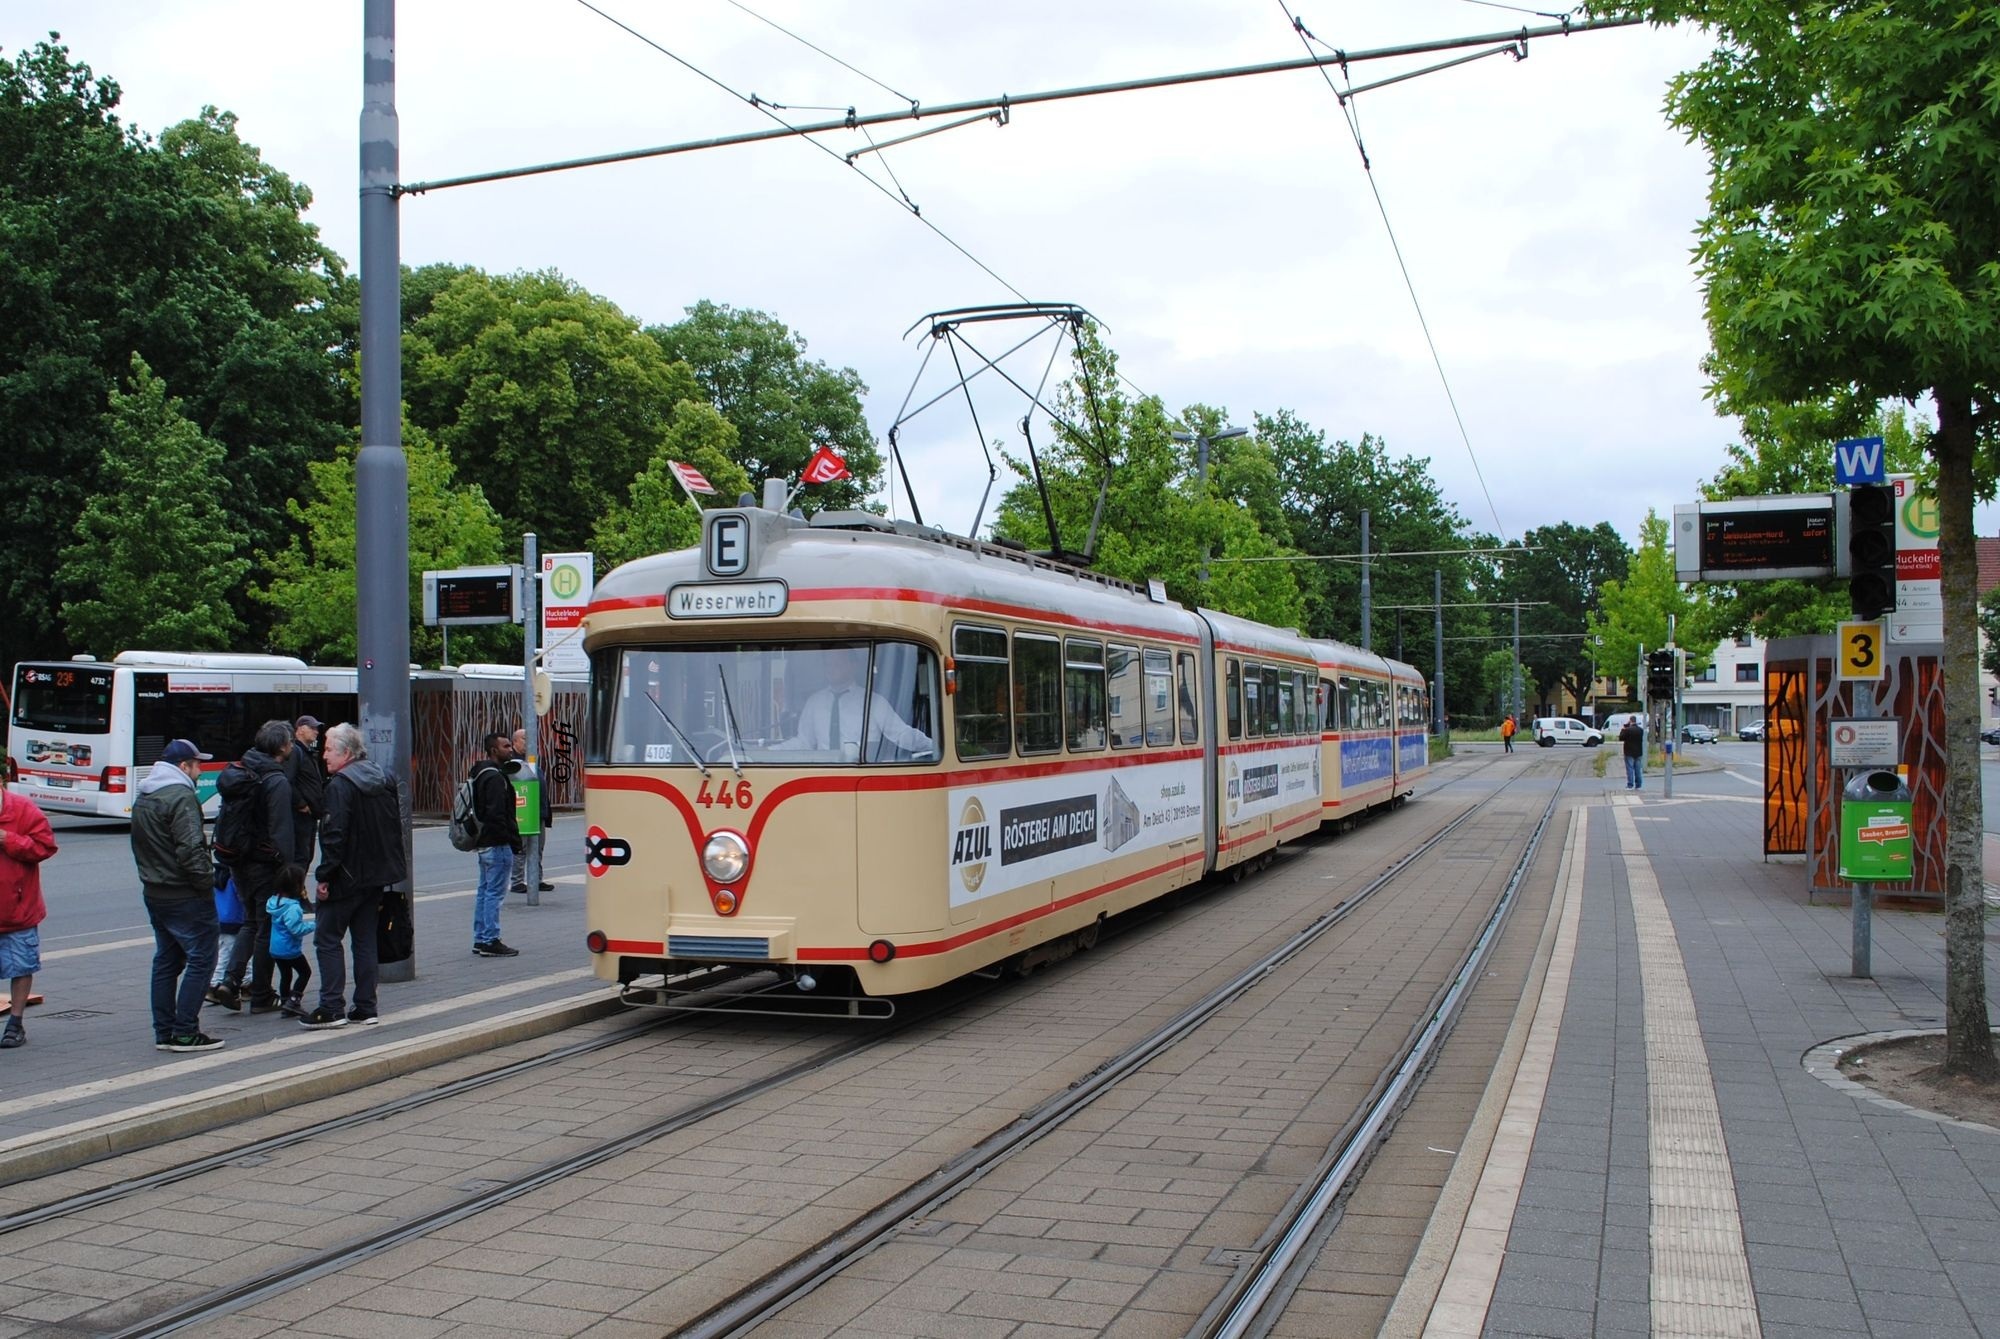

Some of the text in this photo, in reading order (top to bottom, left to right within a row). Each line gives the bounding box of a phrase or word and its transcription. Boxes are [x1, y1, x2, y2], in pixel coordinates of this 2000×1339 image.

[1838, 444, 1880, 477] W
[1895, 486, 1903, 496] B
[717, 521, 738, 568] E
[560, 572, 572, 592] H
[1901, 583, 1907, 592] 4
[680, 591, 777, 611] Weserwehr
[1850, 634, 1874, 668] 3
[646, 746, 672, 759] 4106
[696, 780, 753, 810] 446
[1003, 808, 1095, 850] RÖSTEREI AM DEICH
[1143, 814, 1152, 828] Am
[1152, 810, 1165, 826] Deich
[1186, 804, 1201, 818] Bremen
[952, 825, 992, 865] AZUL
